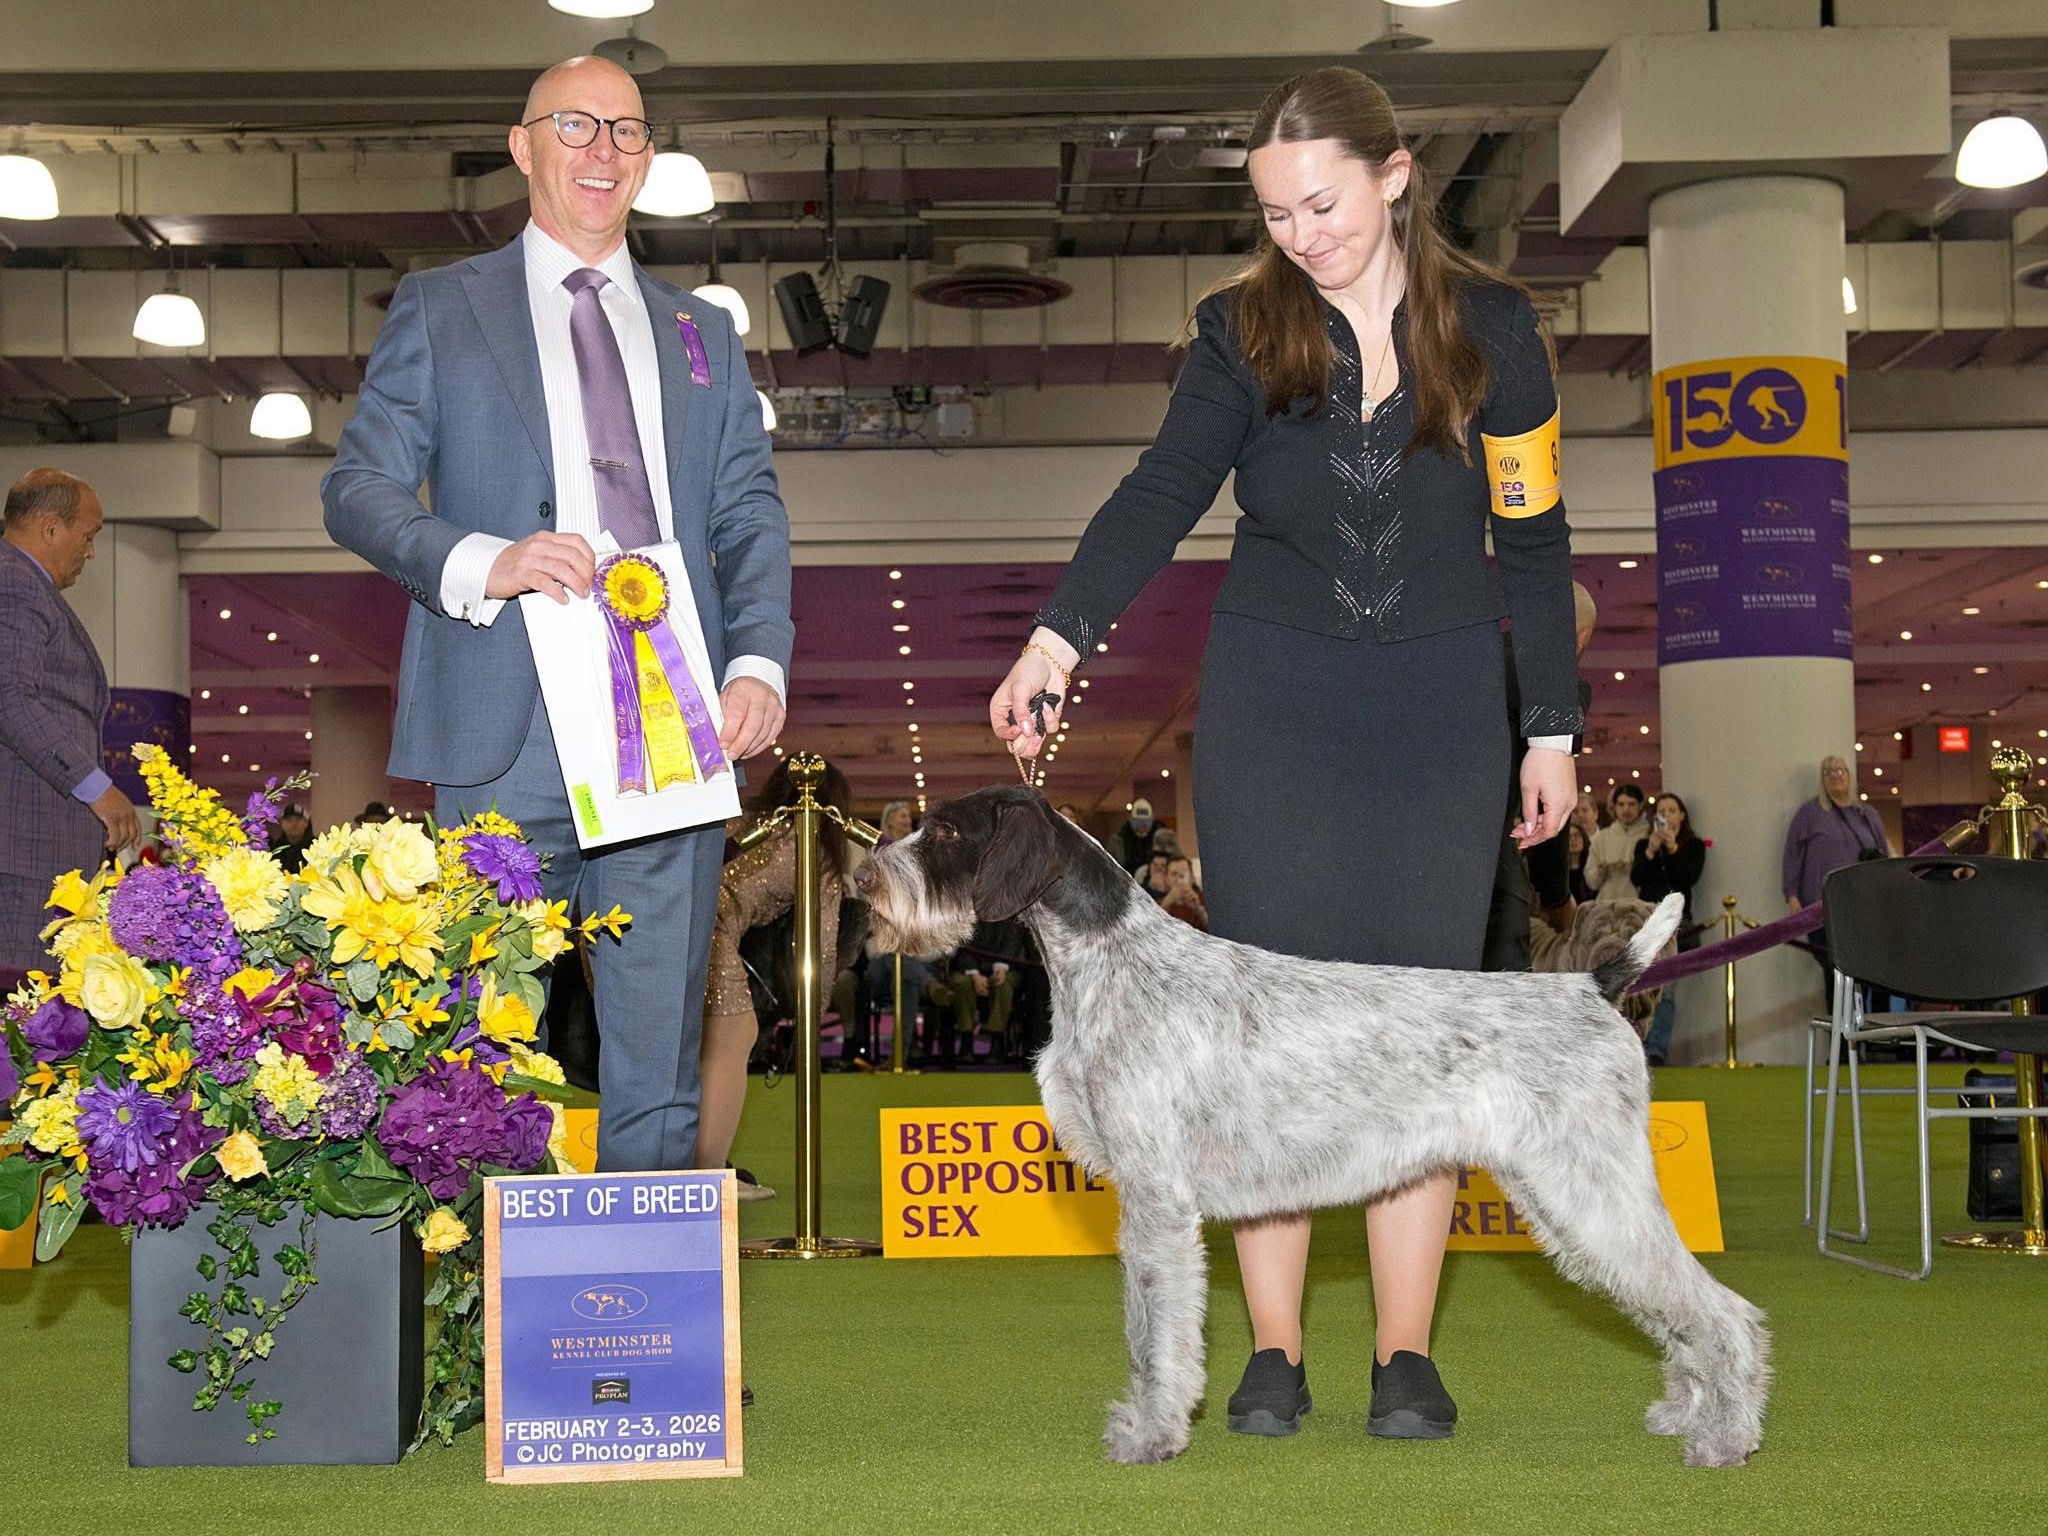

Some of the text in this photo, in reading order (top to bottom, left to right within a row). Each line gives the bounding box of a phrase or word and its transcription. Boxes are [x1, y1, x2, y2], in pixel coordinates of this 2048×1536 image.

[1665, 368, 1807, 453] 150
[900, 1122, 998, 1154] BEST
[504, 1184, 718, 1219] BEST OF BREED
[902, 1205, 980, 1238] SEX
[551, 1333, 672, 1350] WESTMINSTER
[553, 1347, 673, 1359] KENNEL CLUB DOG SHOW
[505, 1414, 721, 1442] FEBRUARY 2-3, 2026
[572, 1440, 707, 1462] Photography
